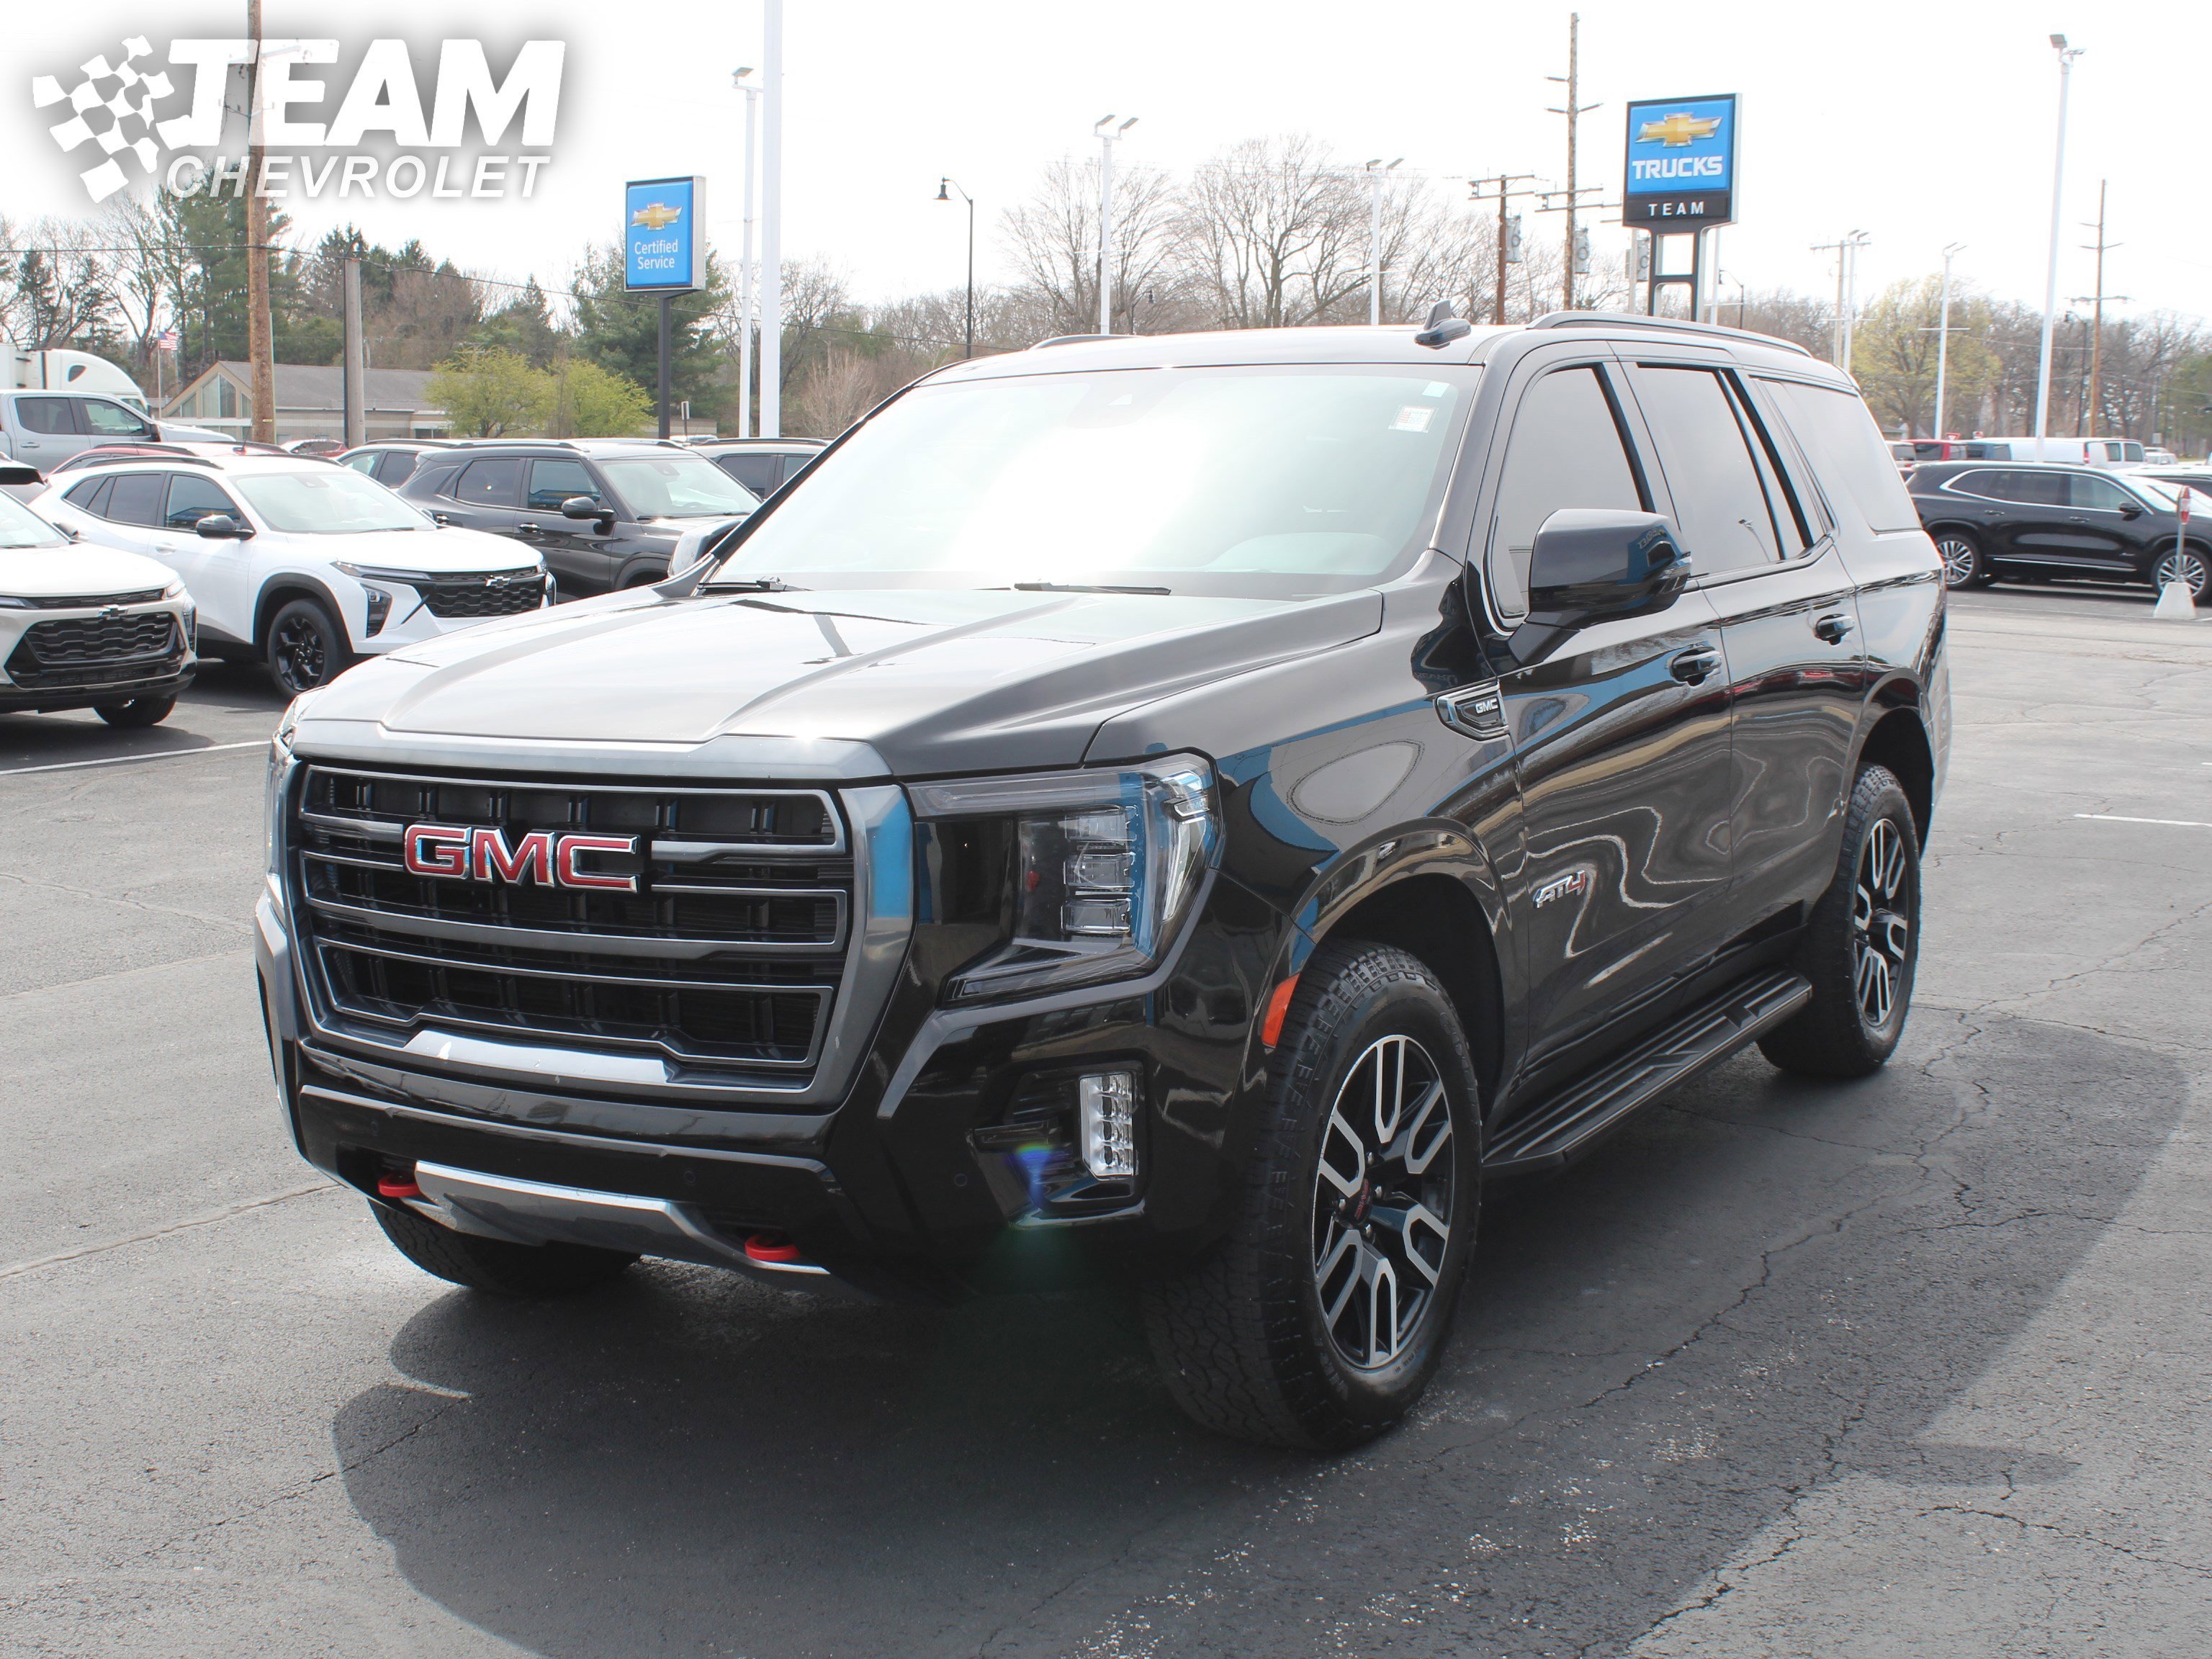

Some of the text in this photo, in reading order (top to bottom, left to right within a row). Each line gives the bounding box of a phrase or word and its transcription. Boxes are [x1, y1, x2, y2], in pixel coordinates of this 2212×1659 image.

[1632, 156, 1723, 179] TRUCKS
[1648, 202, 1705, 217] TEAM
[634, 239, 678, 255] Certified
[637, 256, 675, 270] Service
[1475, 698, 1498, 714] GMC
[404, 823, 641, 894] GMC
[1532, 869, 1586, 909] AT4
